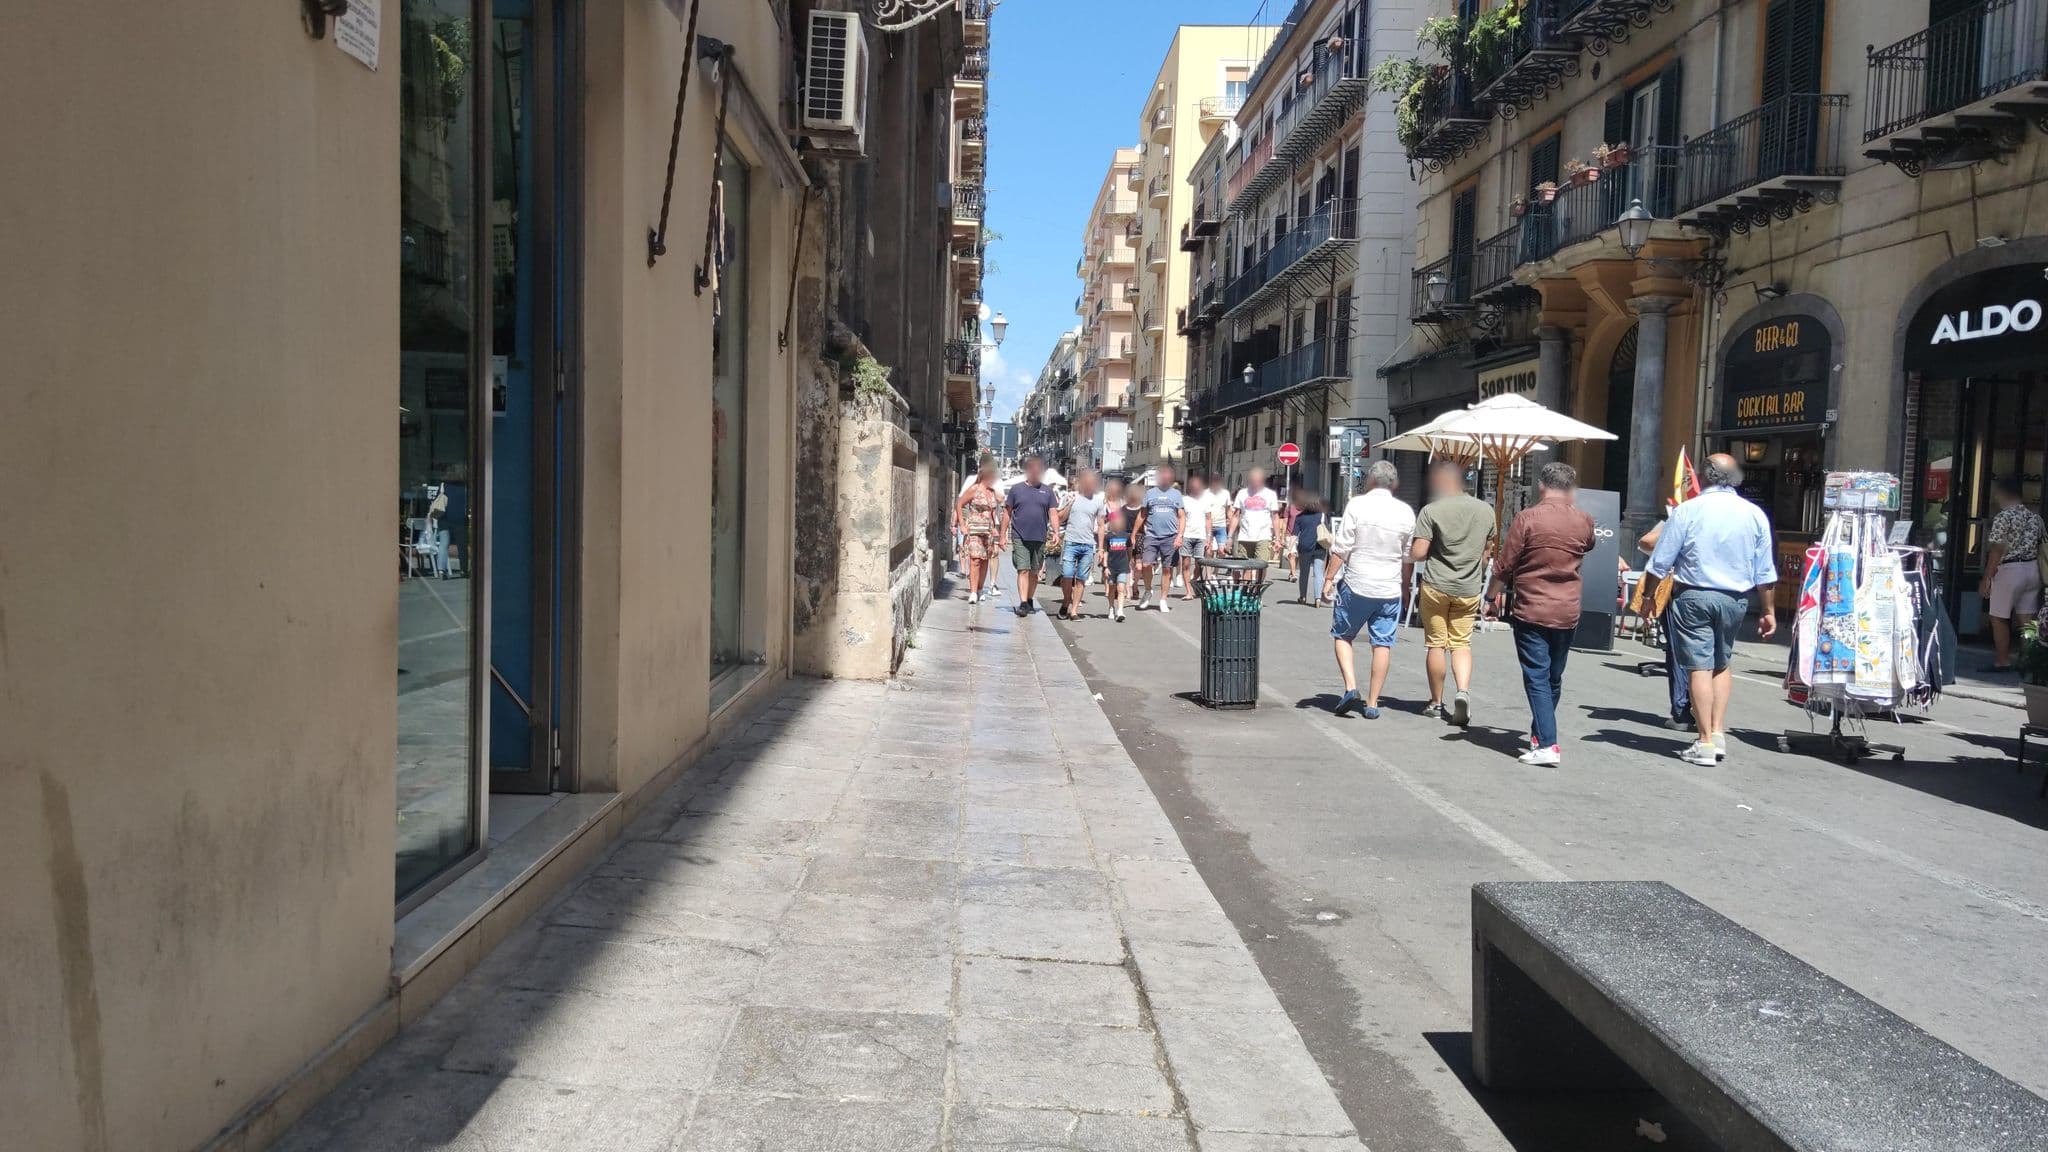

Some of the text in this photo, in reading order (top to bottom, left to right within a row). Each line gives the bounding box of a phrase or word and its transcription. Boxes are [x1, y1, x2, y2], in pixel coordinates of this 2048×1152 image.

[1930, 299, 2042, 345] ALDO
[1480, 371, 1537, 400] SORTINO
[1737, 391, 1805, 418] COCKTAIL BAR
[1594, 528, 1614, 538] DO
